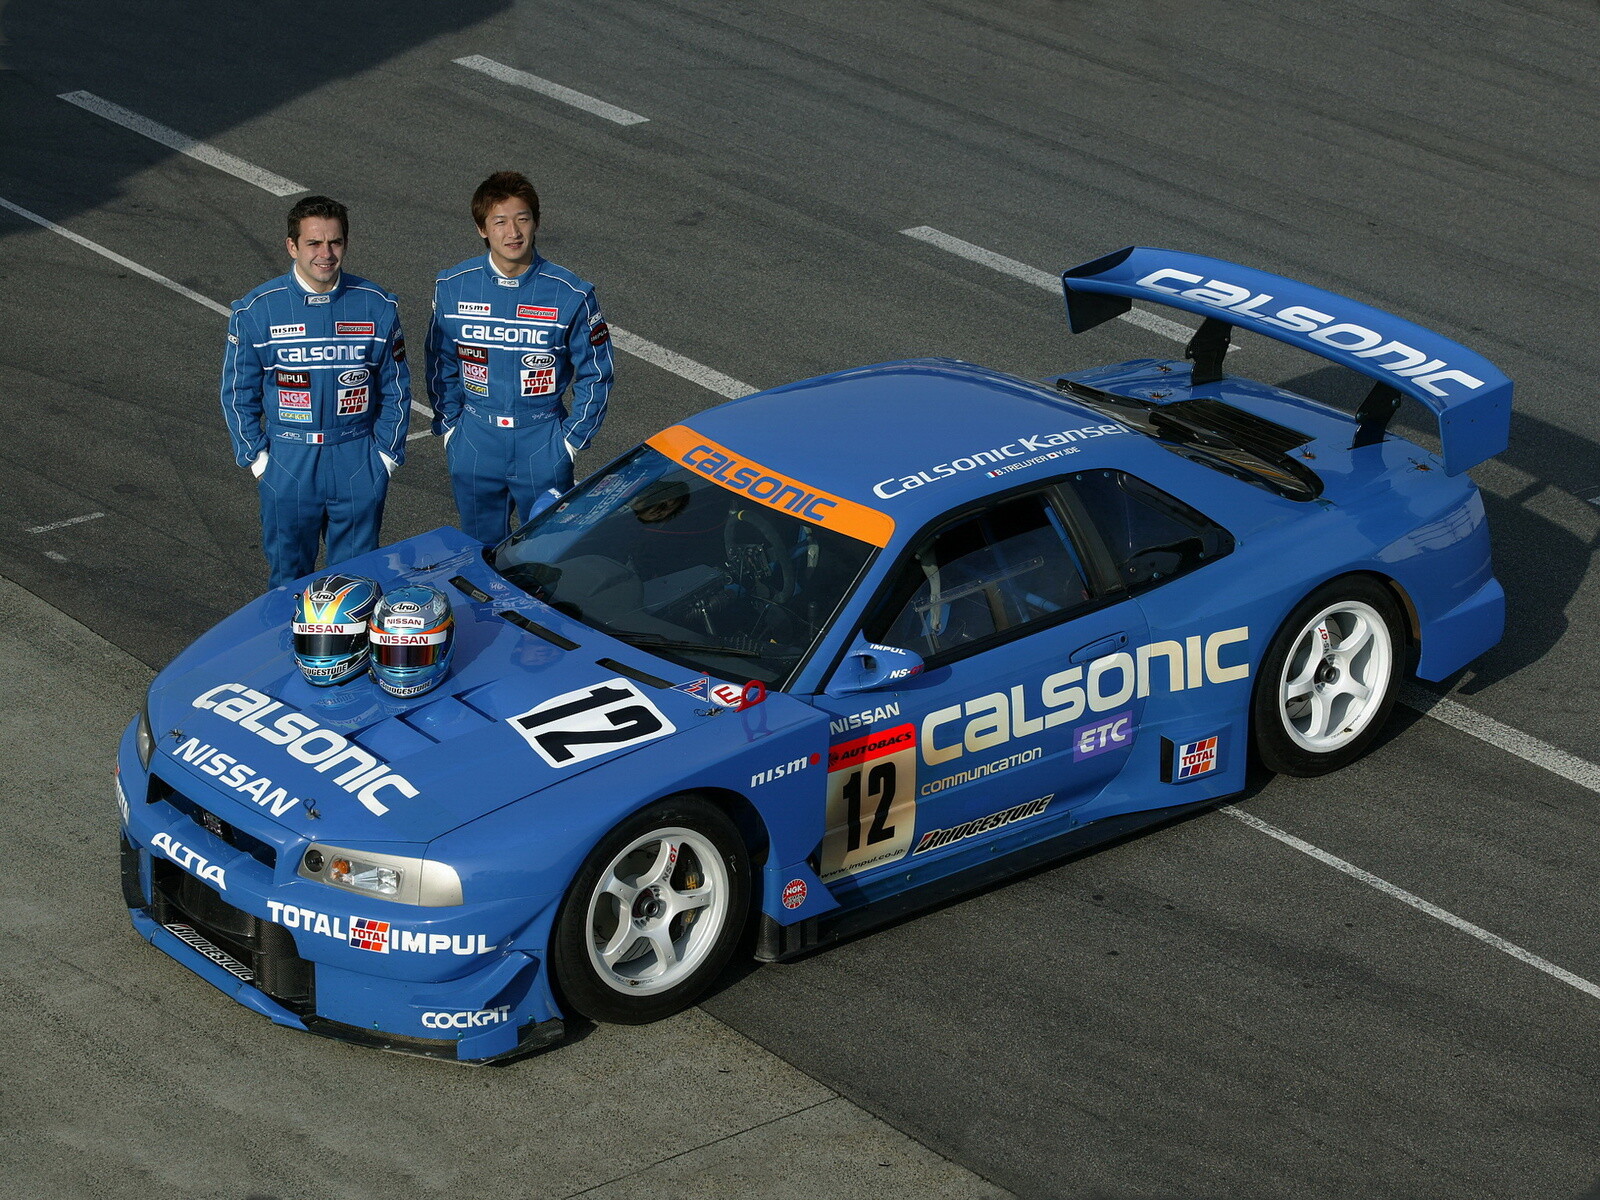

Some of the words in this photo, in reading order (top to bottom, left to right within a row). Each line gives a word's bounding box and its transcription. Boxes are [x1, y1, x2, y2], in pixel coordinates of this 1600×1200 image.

[458, 347, 485, 359] IMPUL
[525, 355, 551, 364] Arai
[341, 371, 366, 382] Arai
[464, 364, 486, 378] NGK
[278, 373, 307, 383] IMPUL
[523, 377, 554, 387] TOTAL
[281, 392, 308, 404] NGK
[340, 396, 367, 406] TOTAL
[313, 592, 334, 600] Arai
[393, 603, 418, 612] Arai
[297, 624, 344, 633] NISSAN
[386, 618, 422, 626] NISSAN
[379, 635, 429, 644] NISSAN
[869, 643, 907, 656] IMPUL
[516, 686, 663, 763] 12
[829, 702, 901, 736] NISSAN
[1077, 717, 1129, 754] ETC
[840, 732, 912, 761] AUTOBACS
[1181, 748, 1215, 767] TOTAL
[172, 737, 300, 818] NISSAN
[842, 761, 896, 853] 12
[912, 793, 1055, 856] BRIDGESTONE
[786, 884, 803, 896] NGK
[266, 900, 347, 940] TOTAL
[350, 927, 388, 943] TOTAL
[391, 929, 498, 956] IMPUL
[421, 1005, 511, 1029] COCKPIT
